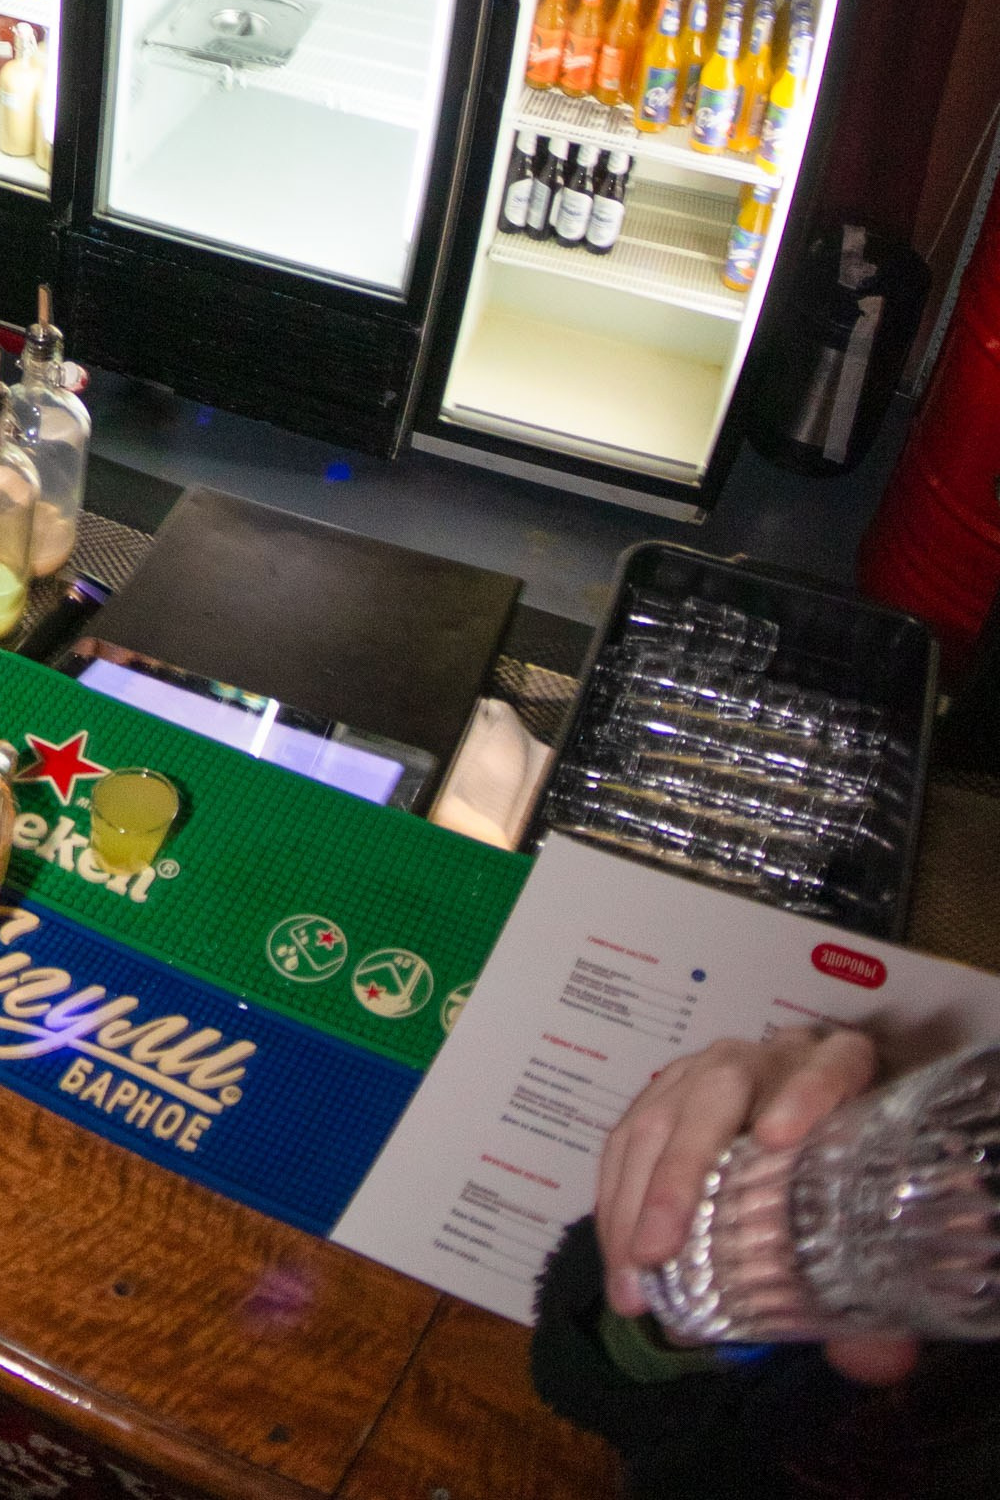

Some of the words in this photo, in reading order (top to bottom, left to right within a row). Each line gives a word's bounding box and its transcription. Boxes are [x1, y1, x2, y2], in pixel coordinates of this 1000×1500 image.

[12, 811, 160, 904] eken
[820, 947, 880, 981] ЗДОРОВЬЕ
[58, 1057, 213, 1153] БАРНОЕ
